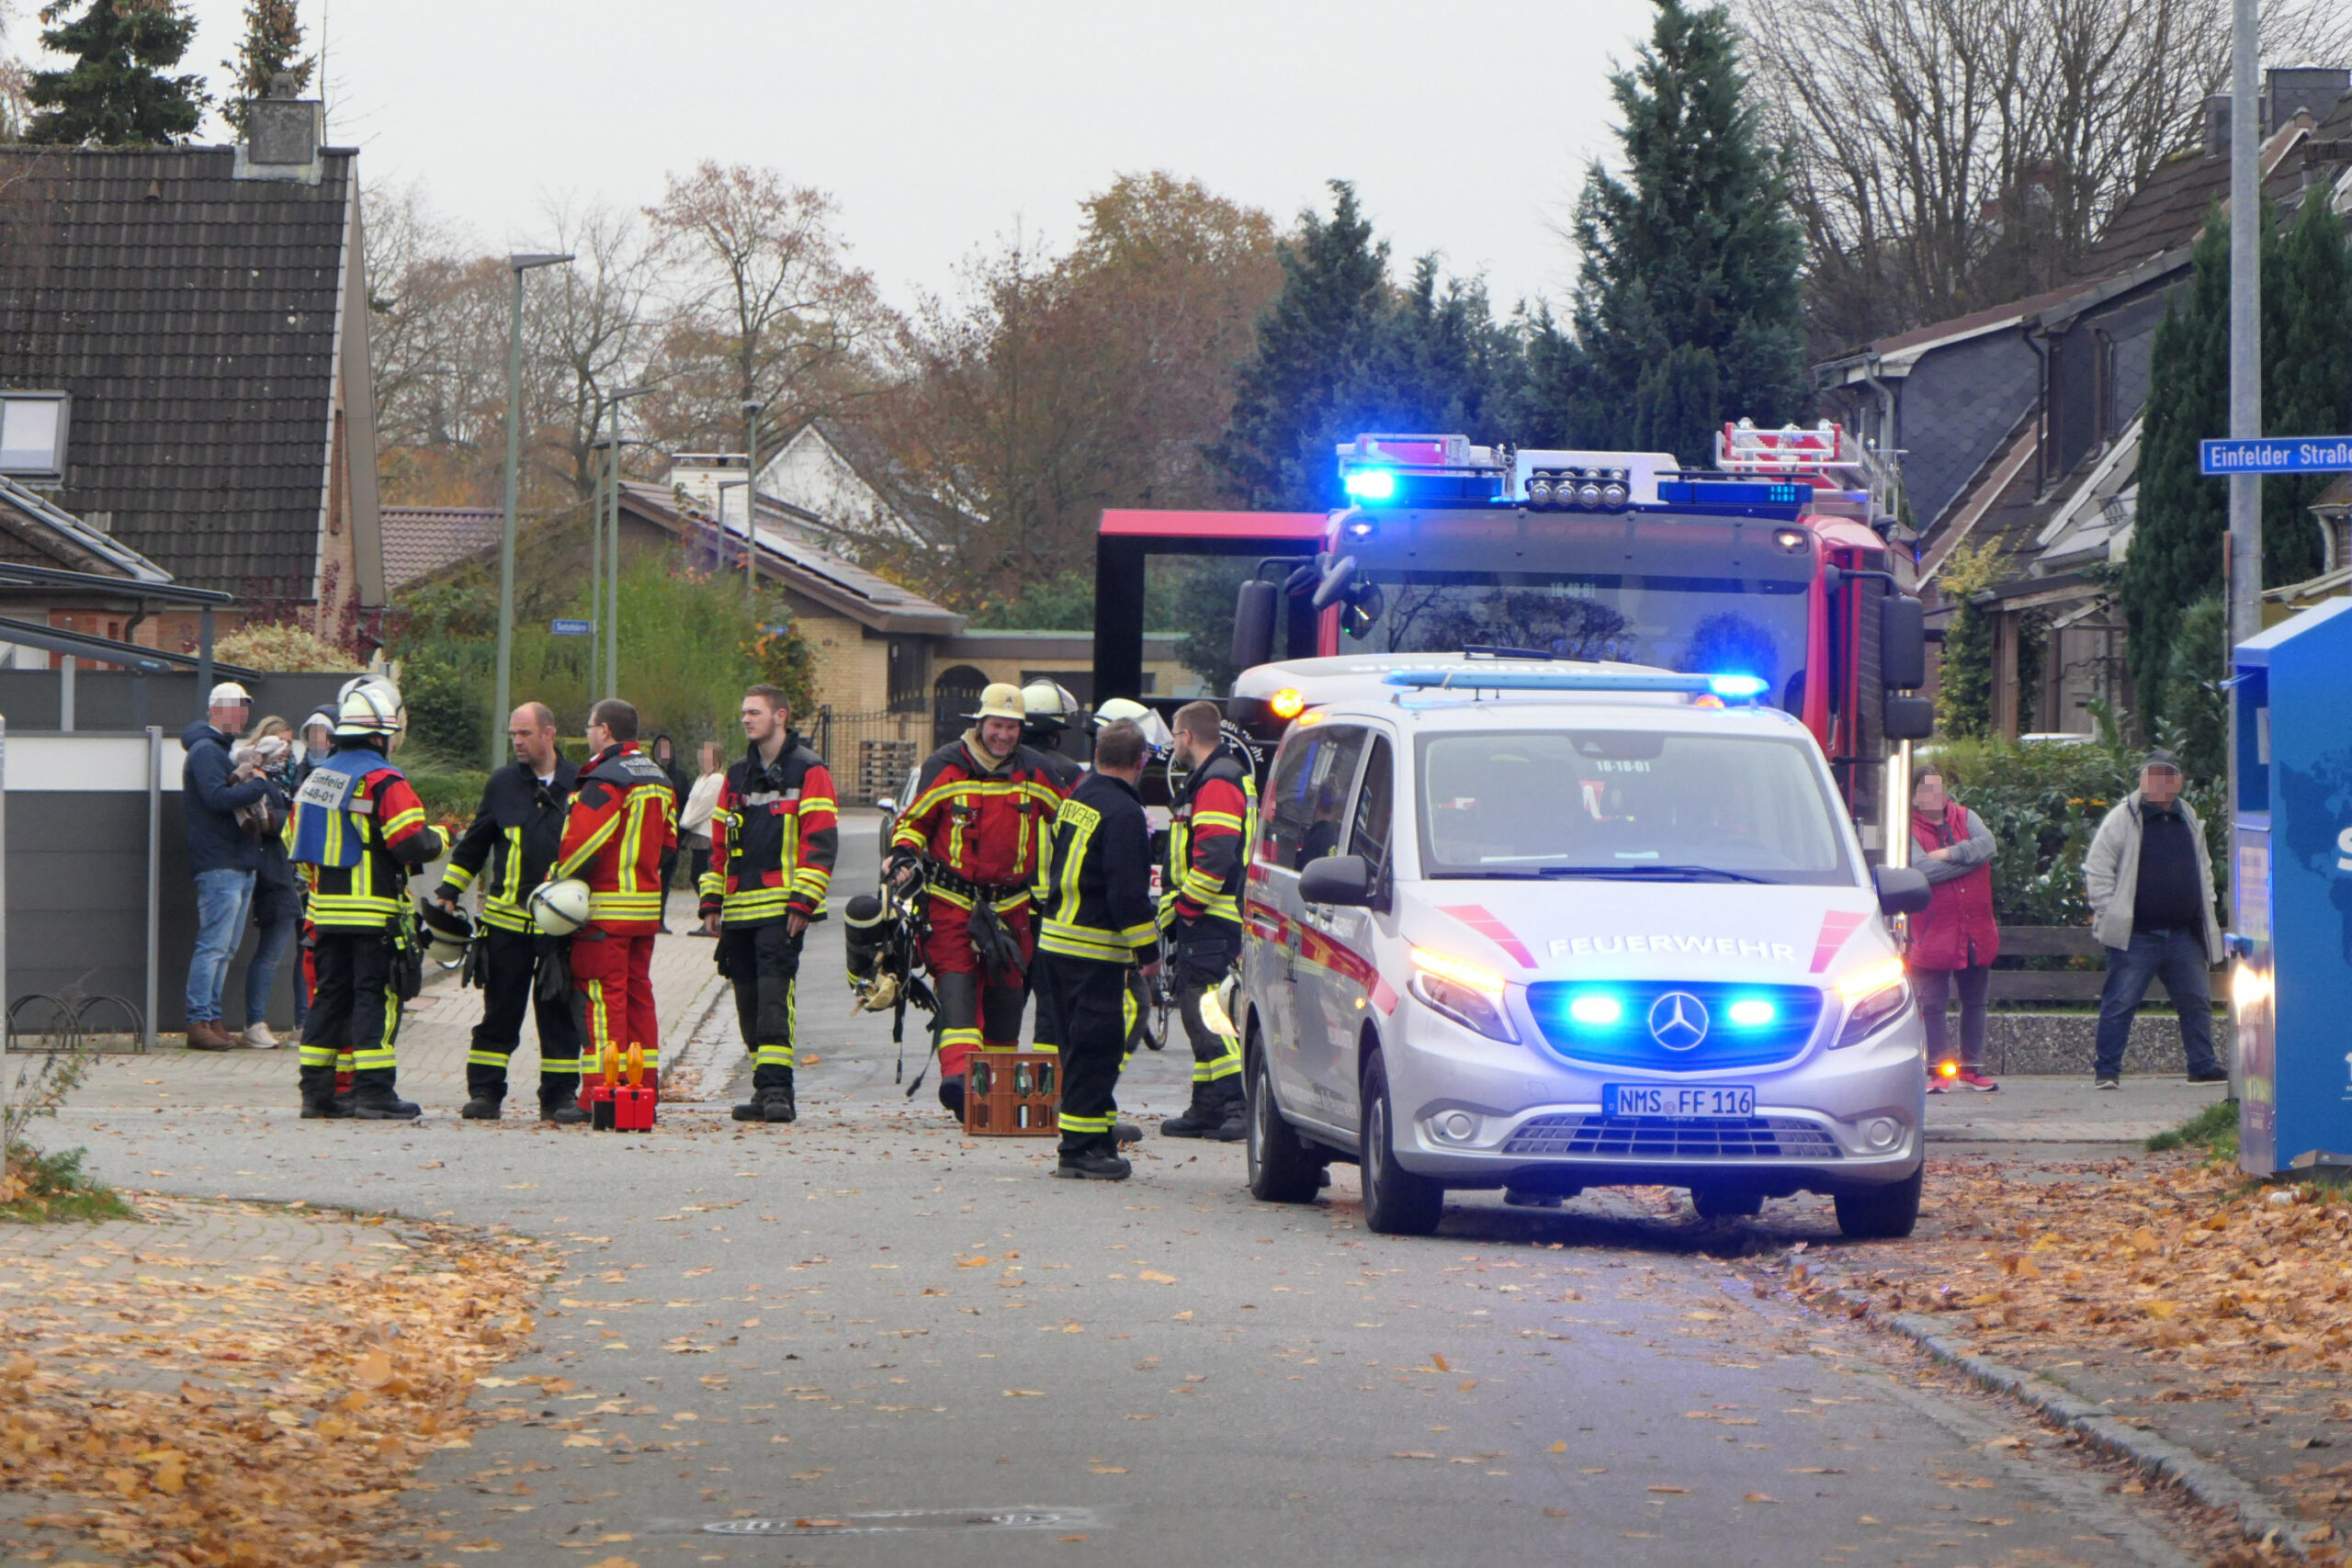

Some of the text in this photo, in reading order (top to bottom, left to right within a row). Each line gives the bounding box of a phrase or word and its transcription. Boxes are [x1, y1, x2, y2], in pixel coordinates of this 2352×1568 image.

[2211, 445, 2291, 468] Einfelder
[1547, 934, 1794, 962] FEUERWEHR
[1620, 1089, 1662, 1113] NMS
[1679, 1090, 1706, 1113] FF
[1712, 1090, 1750, 1114] 116
